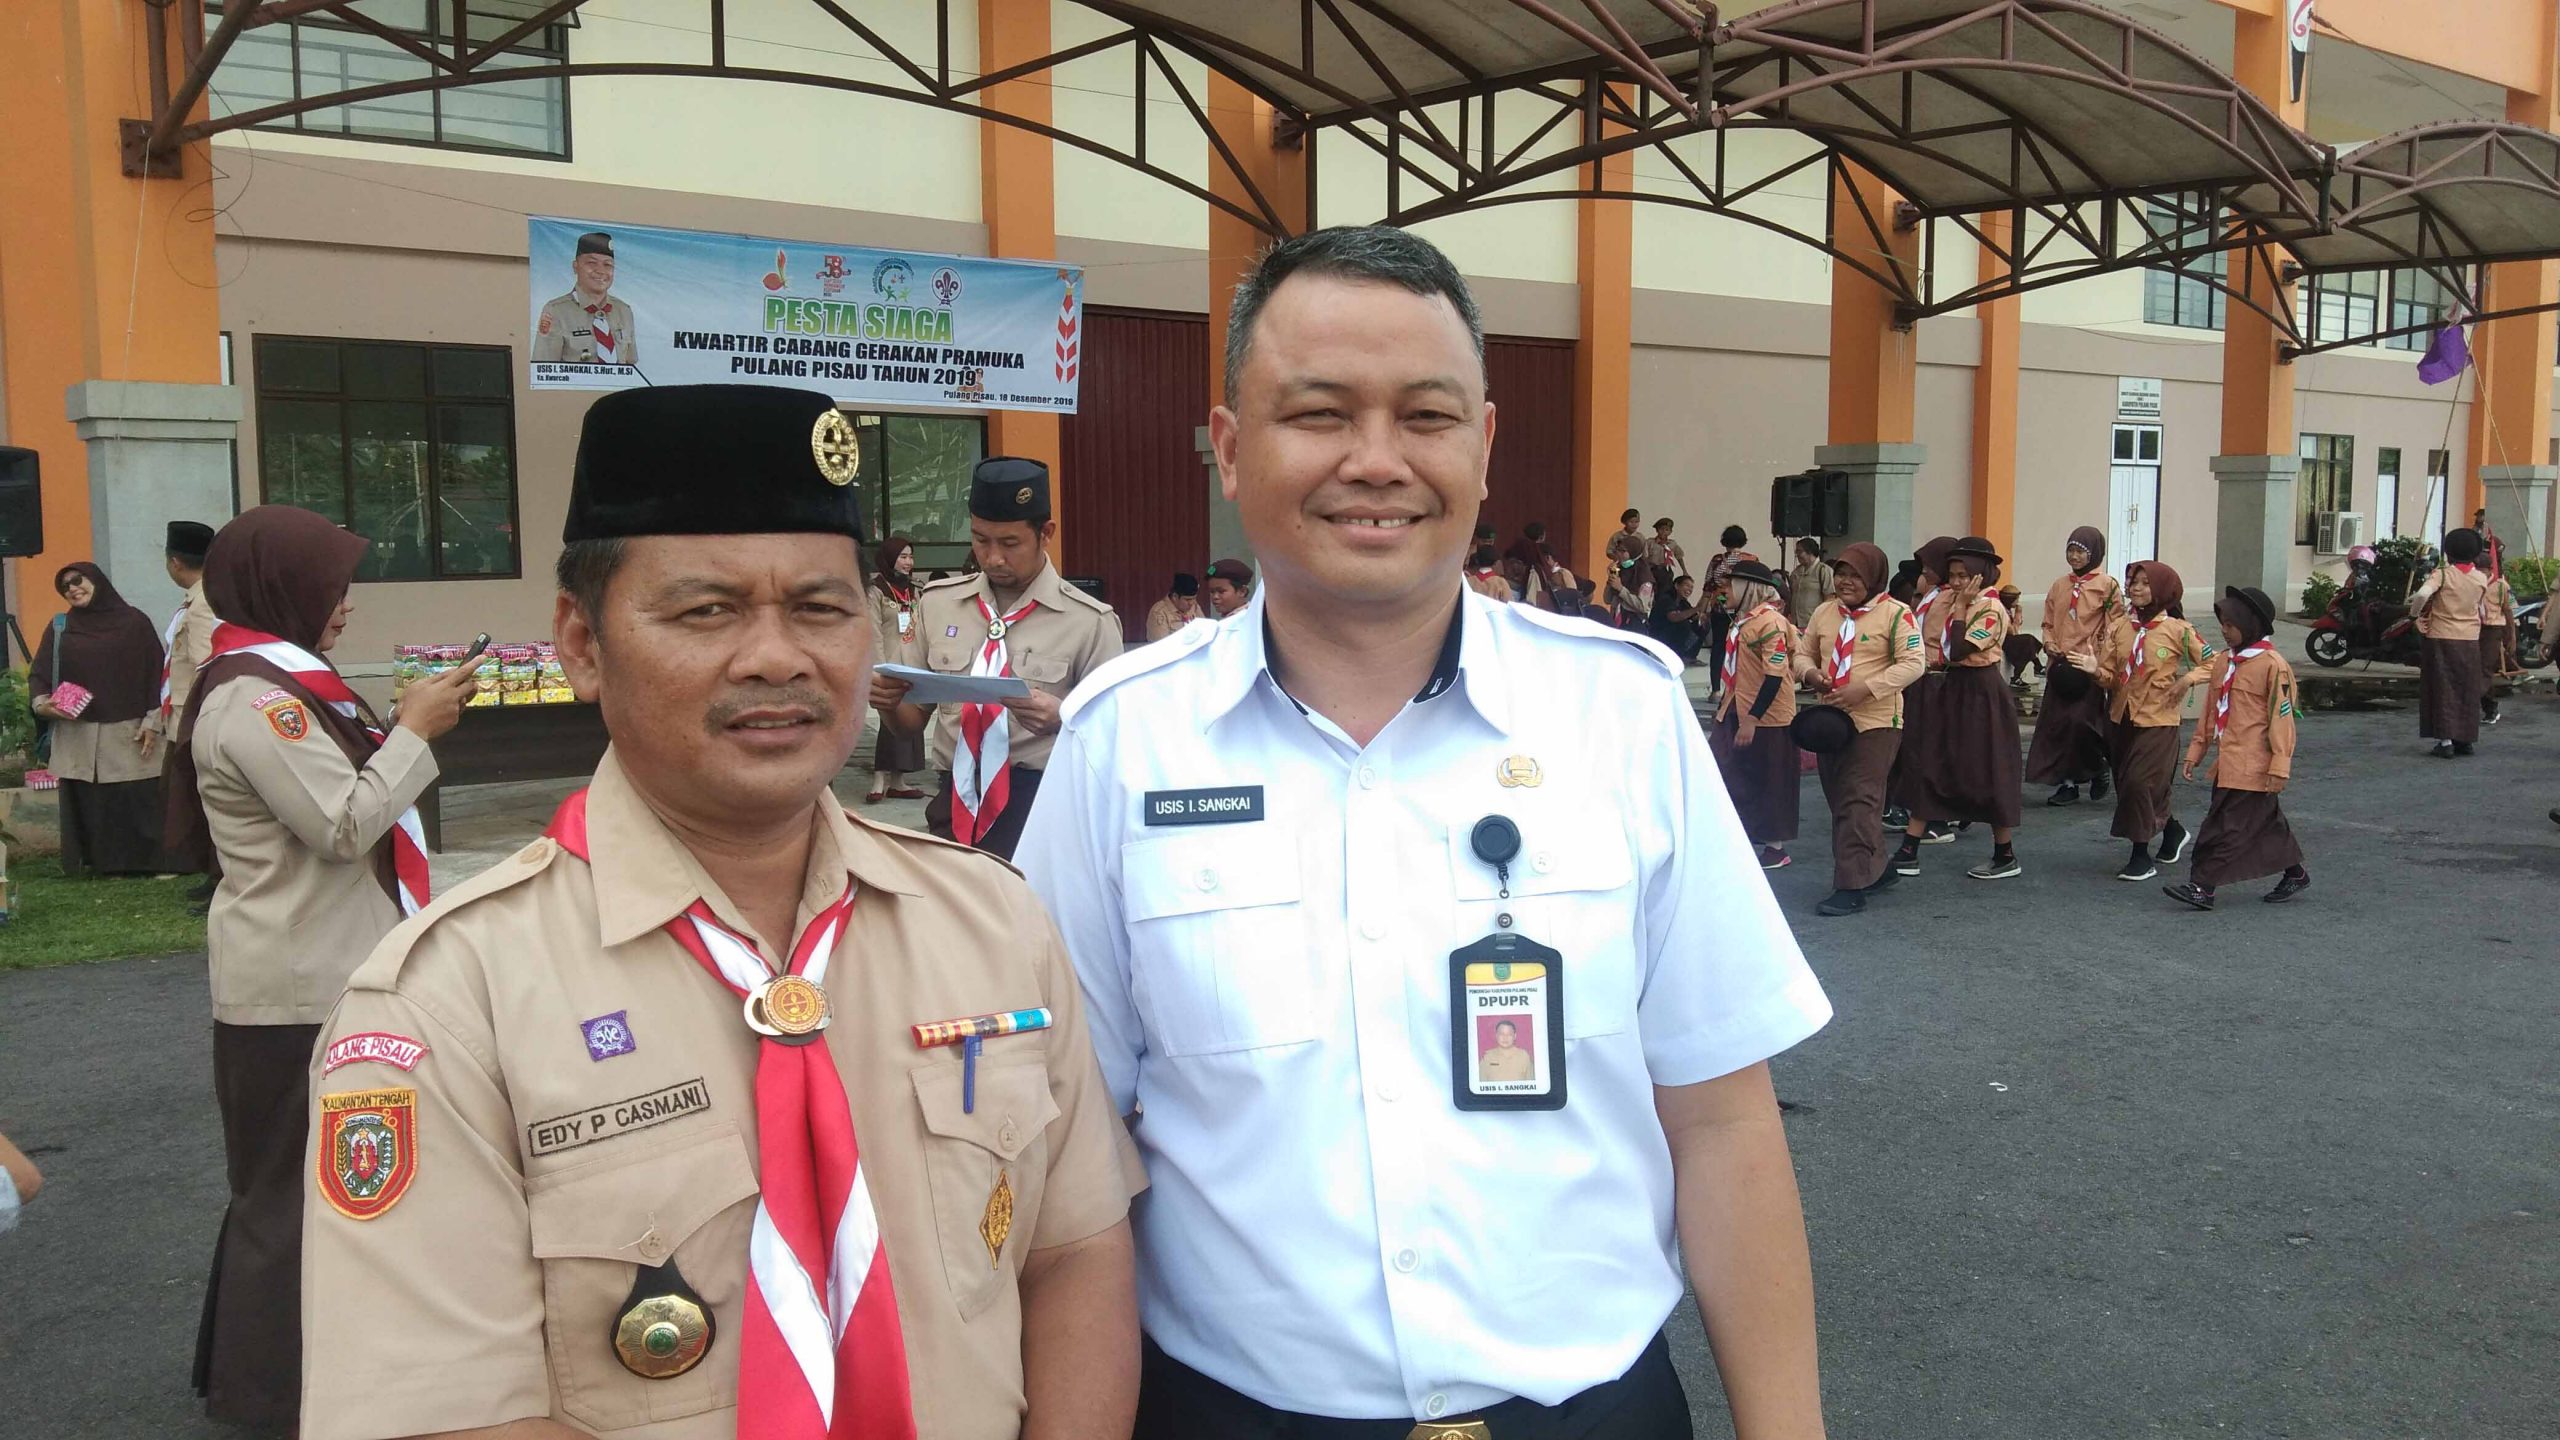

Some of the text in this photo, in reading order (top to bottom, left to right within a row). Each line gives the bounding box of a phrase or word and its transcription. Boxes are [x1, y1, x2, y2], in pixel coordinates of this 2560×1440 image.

[764, 297, 954, 343] PESTA SIAGA
[673, 331, 1025, 369] KWARTIR CABANG GERAKAN PRAMUKA
[536, 364, 553, 374] USIS
[731, 356, 976, 386] PULANG PISAU TAHUN 2019
[943, 390, 971, 400] Pulang
[999, 393, 1008, 401] 18
[1010, 394, 1052, 404] Desember
[1053, 397, 1074, 406] 2019
[1155, 797, 1251, 814] USIS I. SANGKAI
[1478, 995, 1529, 1007] DPUPR
[370, 1037, 416, 1063] PISAU
[322, 1092, 410, 1111] KALIMANTAN TENGAH
[538, 1086, 703, 1148] EDY P CASMANI
